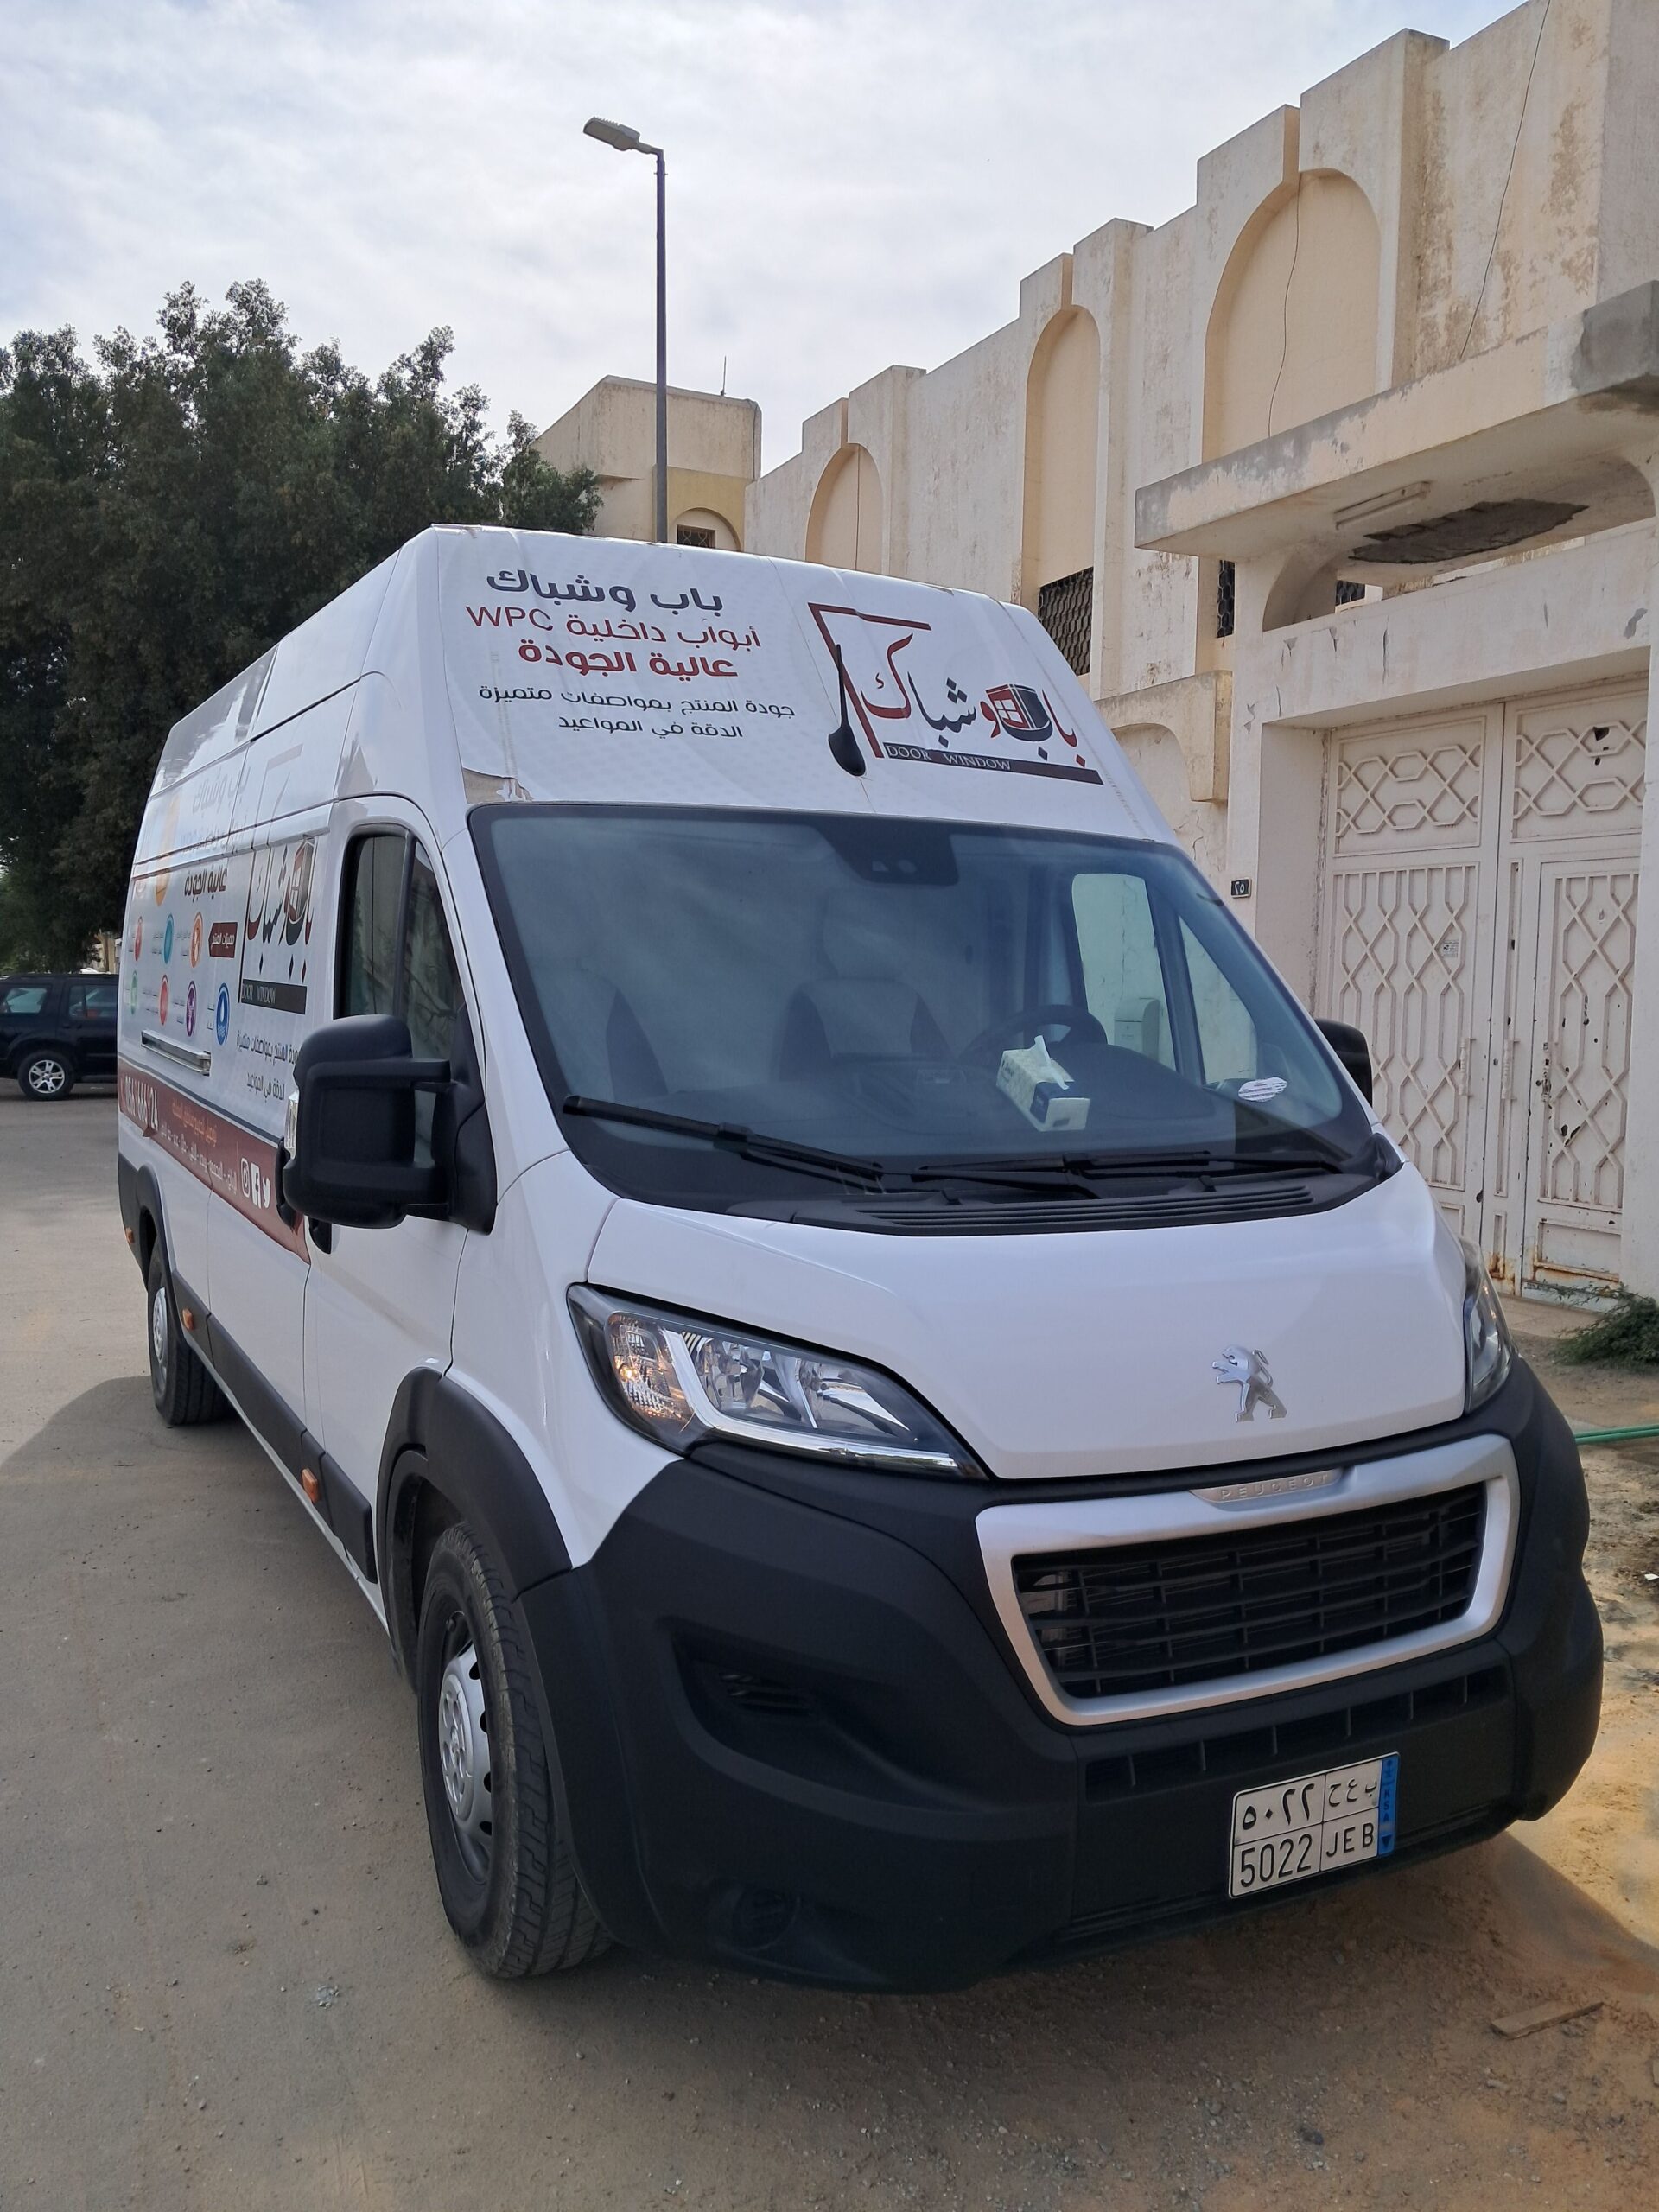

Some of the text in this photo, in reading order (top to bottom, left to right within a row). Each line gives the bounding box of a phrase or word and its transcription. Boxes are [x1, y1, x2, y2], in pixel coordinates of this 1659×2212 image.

[486, 569, 724, 618] باب وشباك
[466, 606, 761, 652] أبواب داخلية WPC
[518, 639, 739, 682] عالية الجودة
[479, 685, 796, 718] جودة المنتج بمواصفات متميزة
[559, 716, 743, 741] الدقة في المواعيد
[887, 743, 1011, 772] DOOR WINDOW
[1221, 1474, 1328, 1499] PEUGEOT
[1240, 1822, 1374, 1888] 5022 JEB
